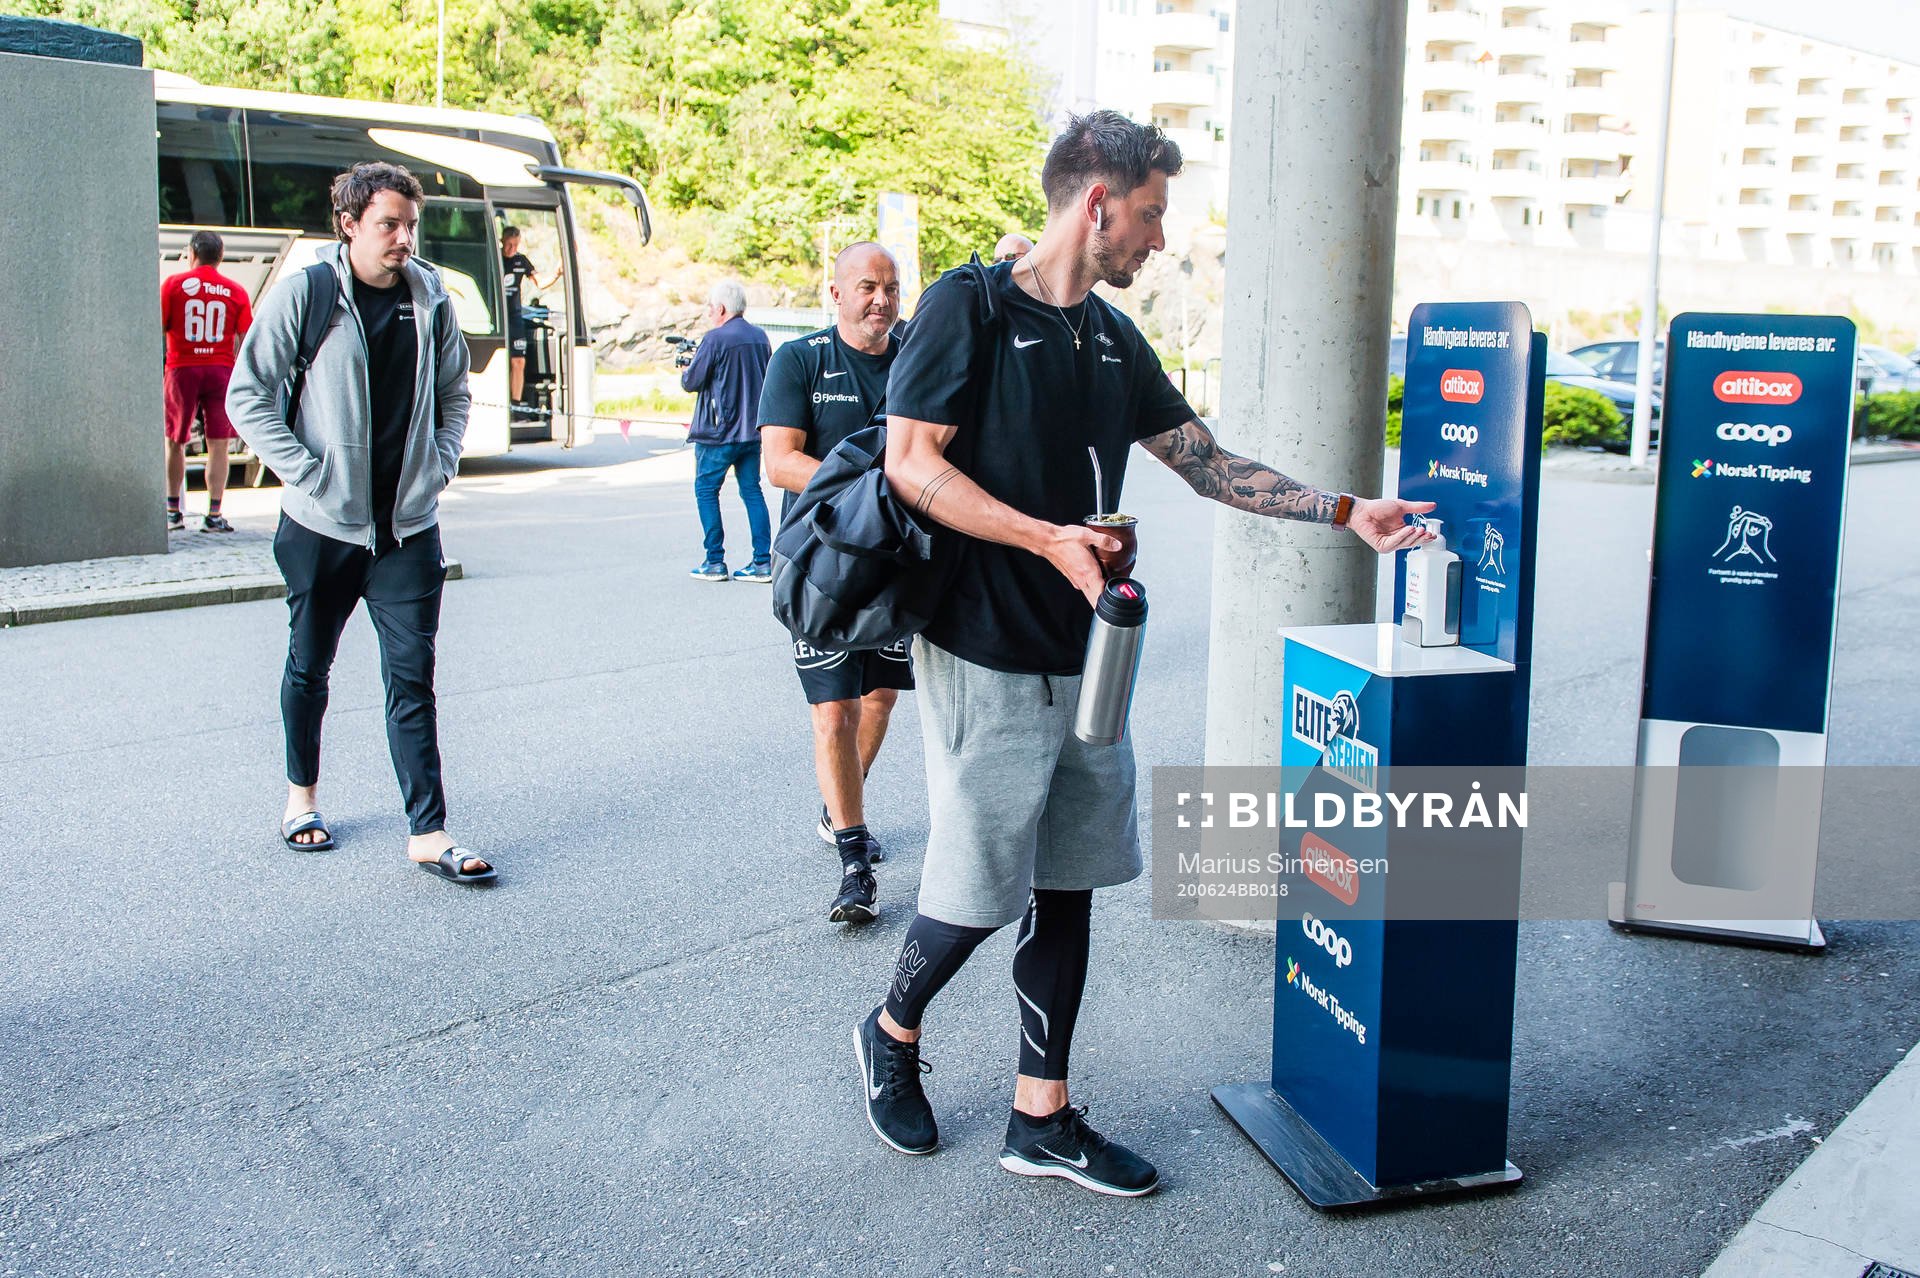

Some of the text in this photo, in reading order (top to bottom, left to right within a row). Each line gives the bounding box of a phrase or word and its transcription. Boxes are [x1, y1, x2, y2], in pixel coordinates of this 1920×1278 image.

[203, 282, 231, 297] Telia
[184, 298, 226, 343] 60
[1423, 326, 1510, 349] Håndhygiene leveres av:
[1687, 330, 1836, 353] Håndhygiene leveres av:
[1444, 375, 1480, 395] altibox
[1720, 377, 1794, 397] altibox
[1440, 422, 1479, 448] coop
[1716, 422, 1793, 447] coop
[1440, 464, 1488, 488] Norsk Tipping
[1715, 462, 1812, 484] Norsk Tipping
[1295, 692, 1332, 747] ELITE
[1328, 736, 1374, 789] SERIEN
[1302, 911, 1352, 969] coop
[1302, 971, 1367, 1045] Norsk Tipping
